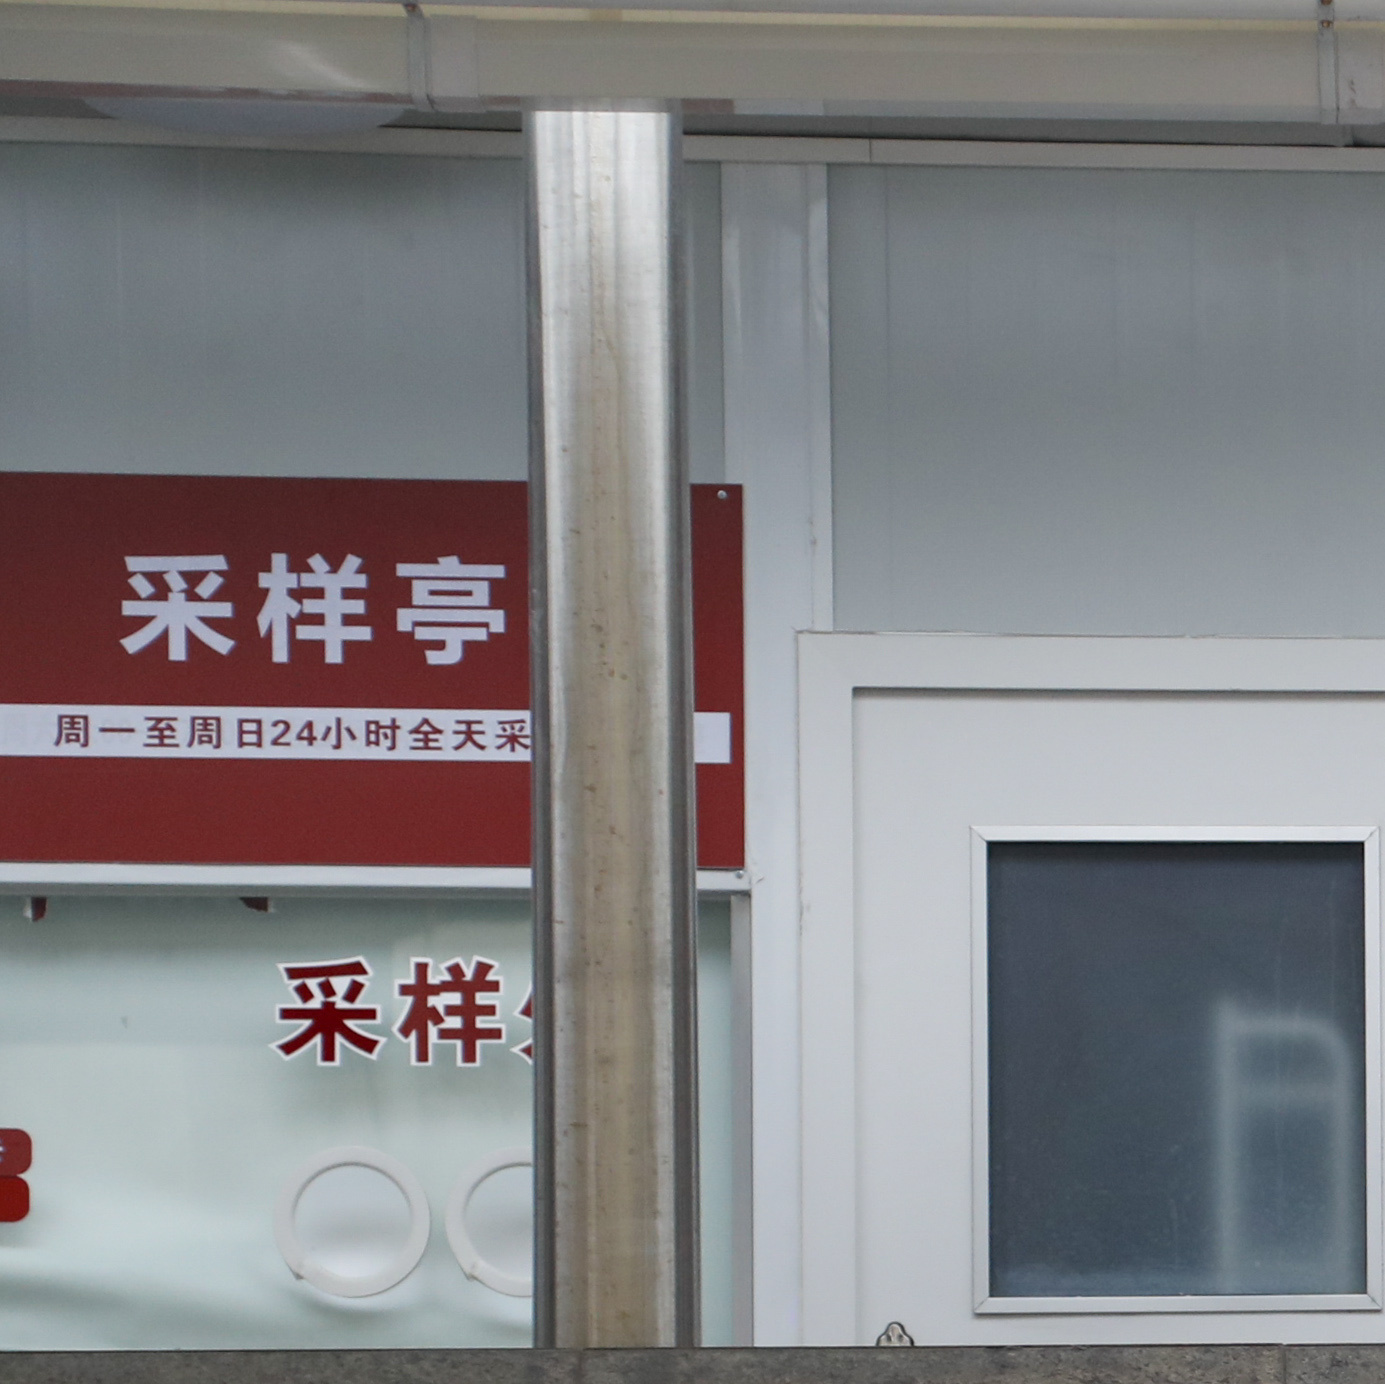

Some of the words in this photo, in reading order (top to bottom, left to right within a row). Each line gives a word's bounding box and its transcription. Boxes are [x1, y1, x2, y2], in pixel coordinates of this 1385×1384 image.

[119, 552, 506, 665] 采样亭
[53, 714, 531, 752] 周一至周日24小时全天采
[269, 955, 532, 1067] 采样
